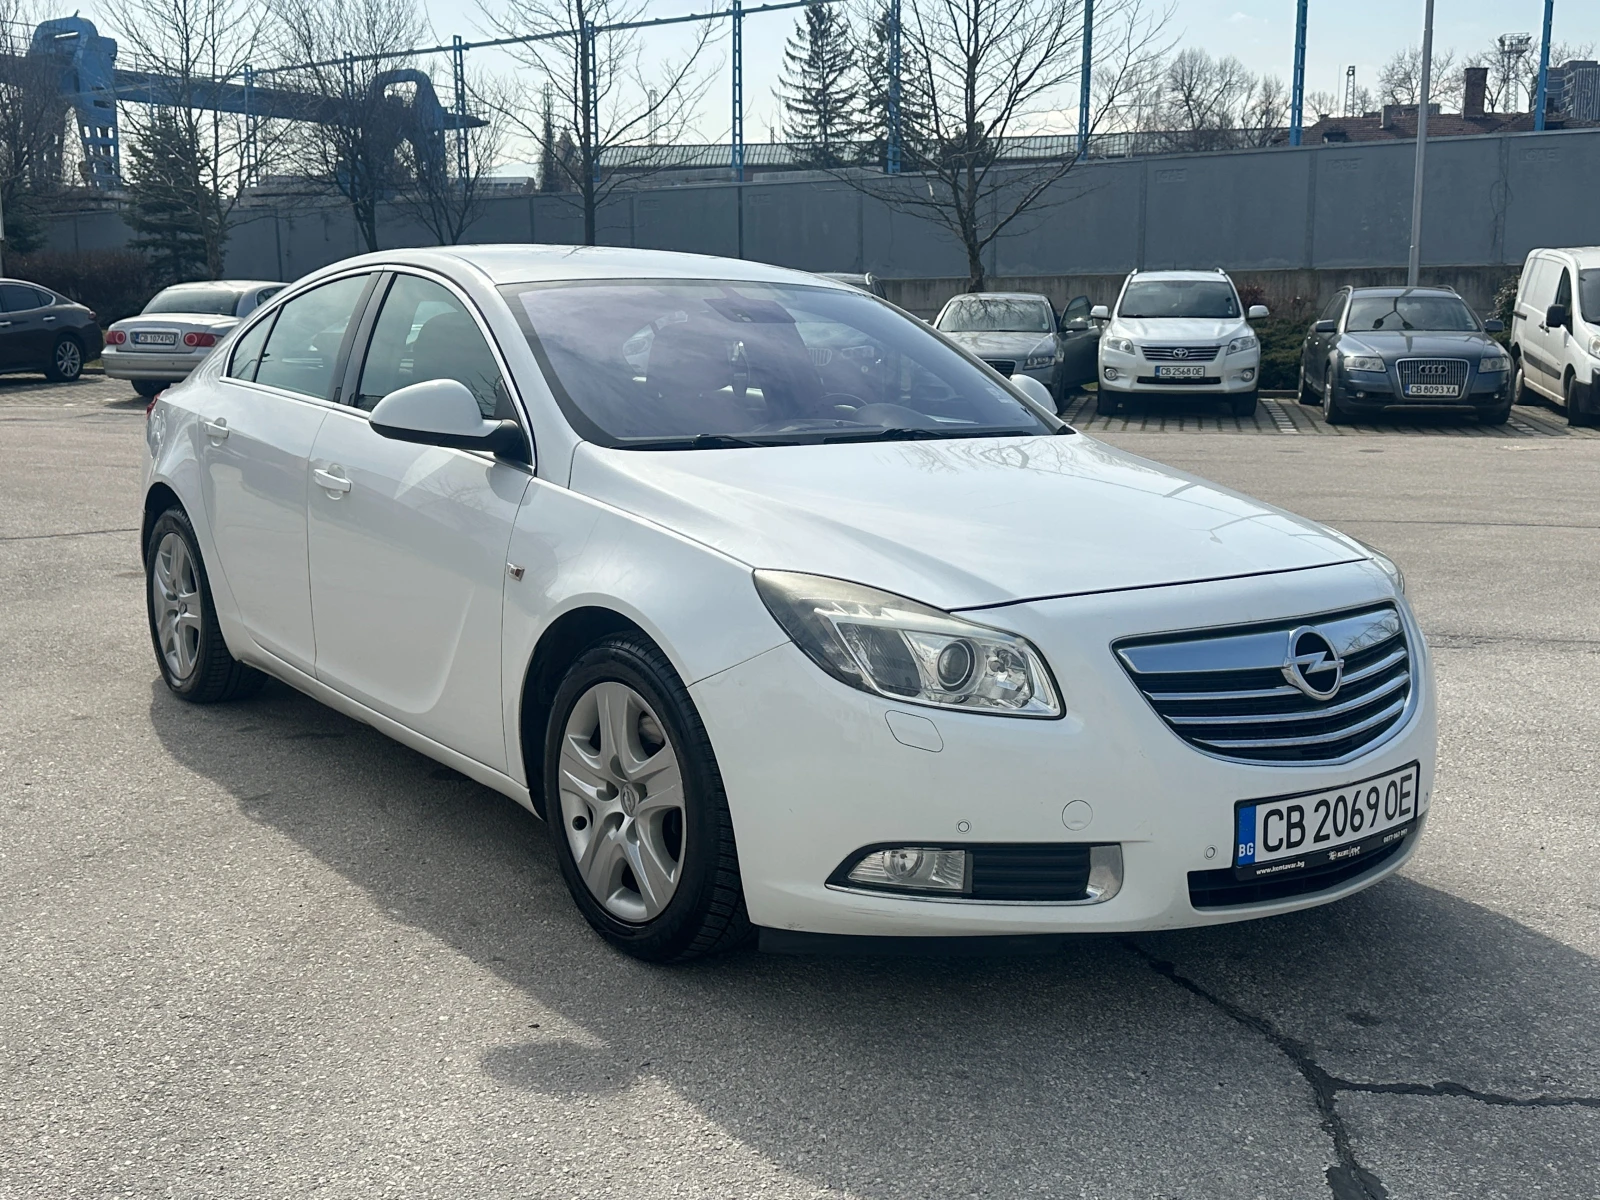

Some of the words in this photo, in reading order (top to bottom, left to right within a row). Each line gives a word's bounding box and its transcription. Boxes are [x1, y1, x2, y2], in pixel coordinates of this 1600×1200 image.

[140, 334, 148, 342] CB
[150, 334, 164, 342] 1074
[1262, 804, 1306, 853] CB
[1313, 786, 1380, 844] 2069
[1384, 773, 1413, 821] OE
[1238, 842, 1254, 857] BG
[1256, 861, 1305, 875] www.kentavar.bg
